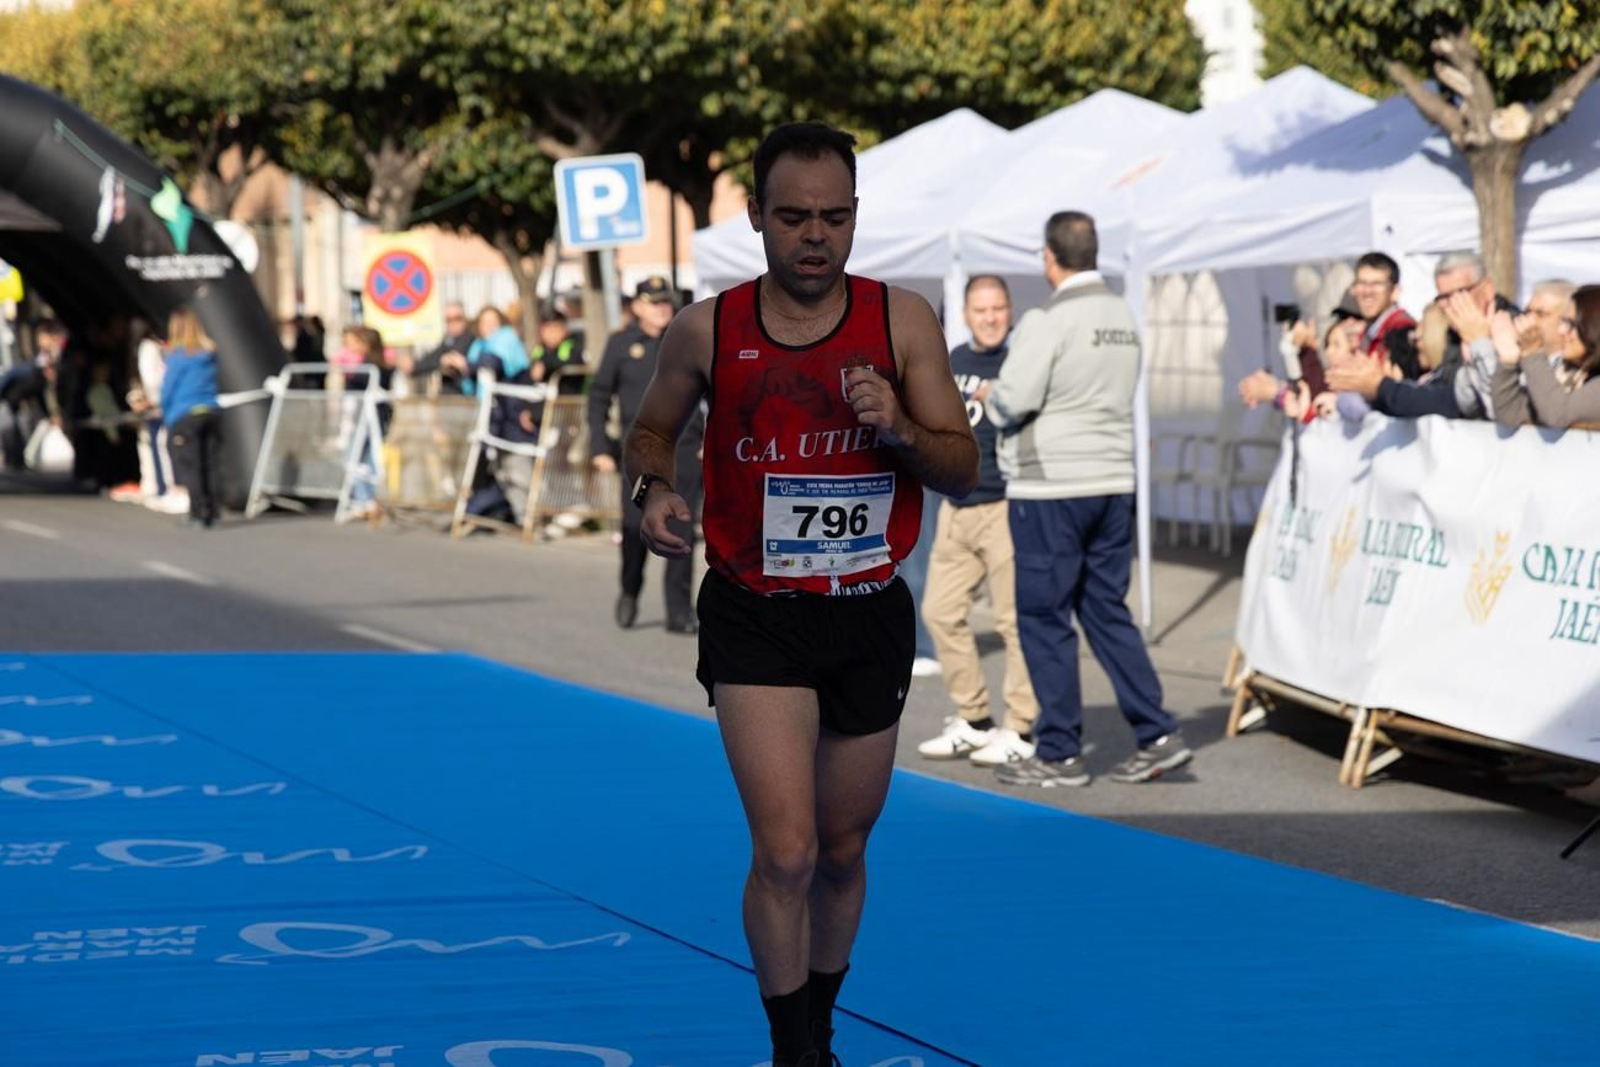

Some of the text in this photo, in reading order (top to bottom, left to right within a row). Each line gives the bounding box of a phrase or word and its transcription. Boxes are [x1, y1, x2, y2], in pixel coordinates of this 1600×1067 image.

[573, 167, 629, 239] P
[735, 437, 786, 462] C.A.
[792, 503, 869, 538] 796
[817, 541, 851, 550] SAMUEL
[0, 949, 193, 964] MEDI
[196, 1045, 404, 1067] JAÉN
